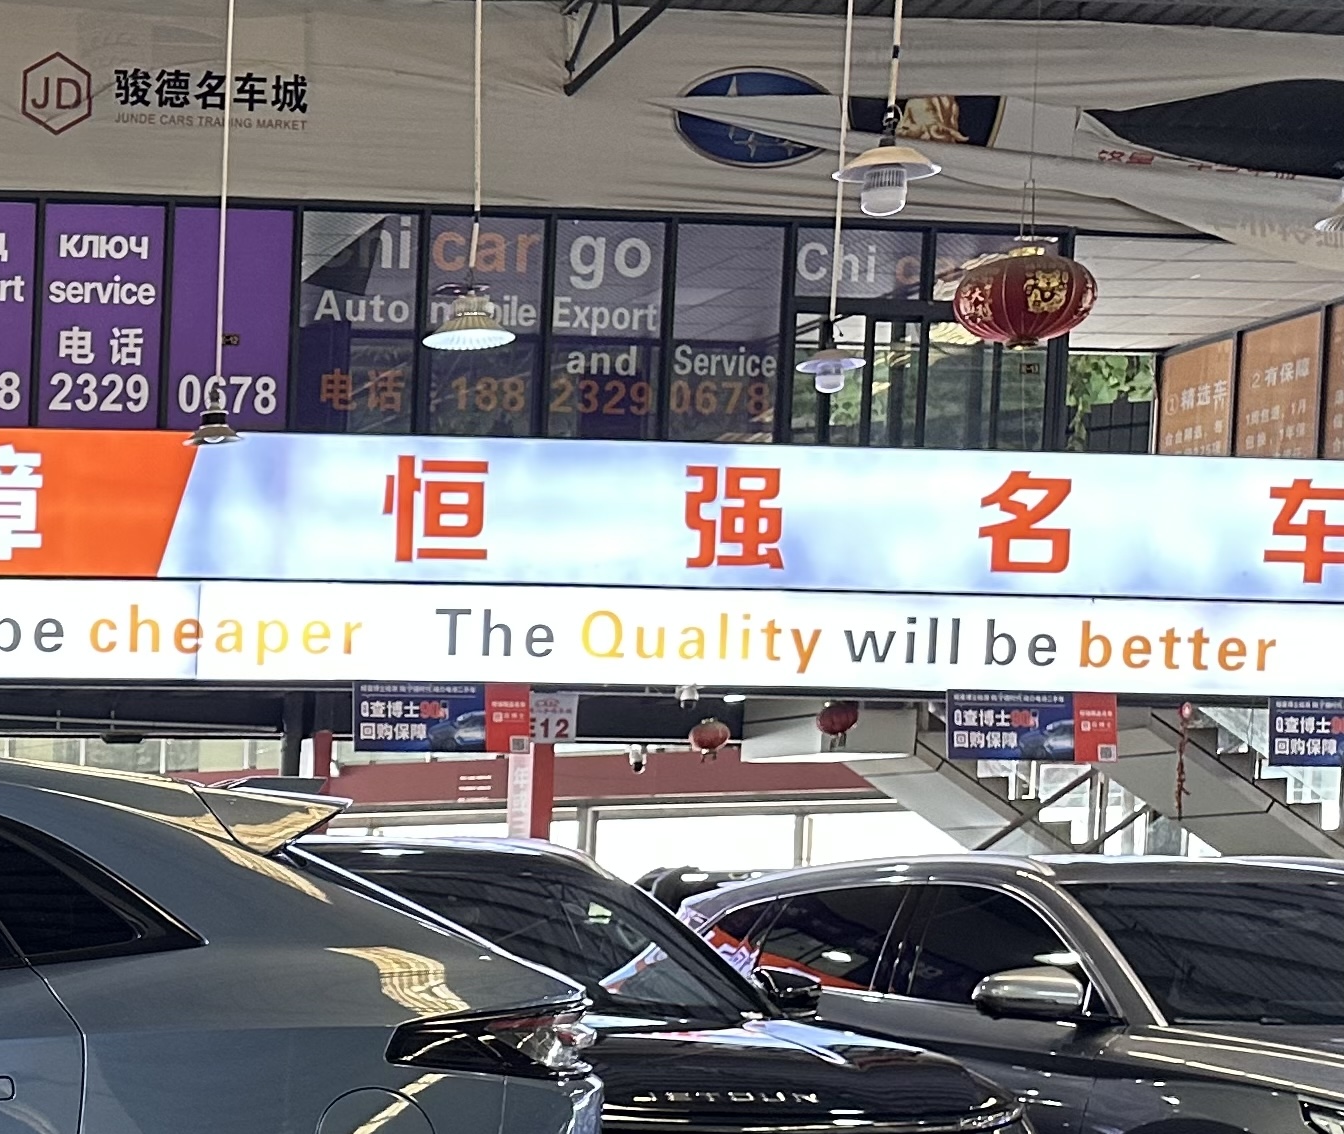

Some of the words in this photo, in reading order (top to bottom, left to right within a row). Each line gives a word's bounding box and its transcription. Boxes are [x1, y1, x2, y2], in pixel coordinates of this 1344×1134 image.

[31, 76, 82, 110] JD
[114, 67, 308, 114] 骏德名车城
[114, 112, 155, 125] JUNDE
[160, 114, 193, 128] CARS
[256, 118, 308, 131] MARKET
[59, 233, 149, 259] ключ
[569, 232, 651, 290] go
[48, 275, 156, 305] service
[314, 290, 409, 323] Auto
[430, 294, 537, 327] mile
[553, 296, 657, 336] Export
[59, 326, 143, 366] 电话
[567, 346, 636, 376] and
[673, 344, 777, 376] Service
[48, 372, 149, 413] 2329
[178, 374, 277, 414] 0678
[452, 376, 525, 412] 188
[549, 377, 652, 415] 2329
[669, 381, 771, 416] 0678
[88, 604, 363, 665] cheaper
[435, 608, 554, 658] The
[580, 609, 822, 674] Quality
[843, 616, 959, 665] will
[985, 619, 1058, 666] be
[1079, 620, 1277, 672] better
